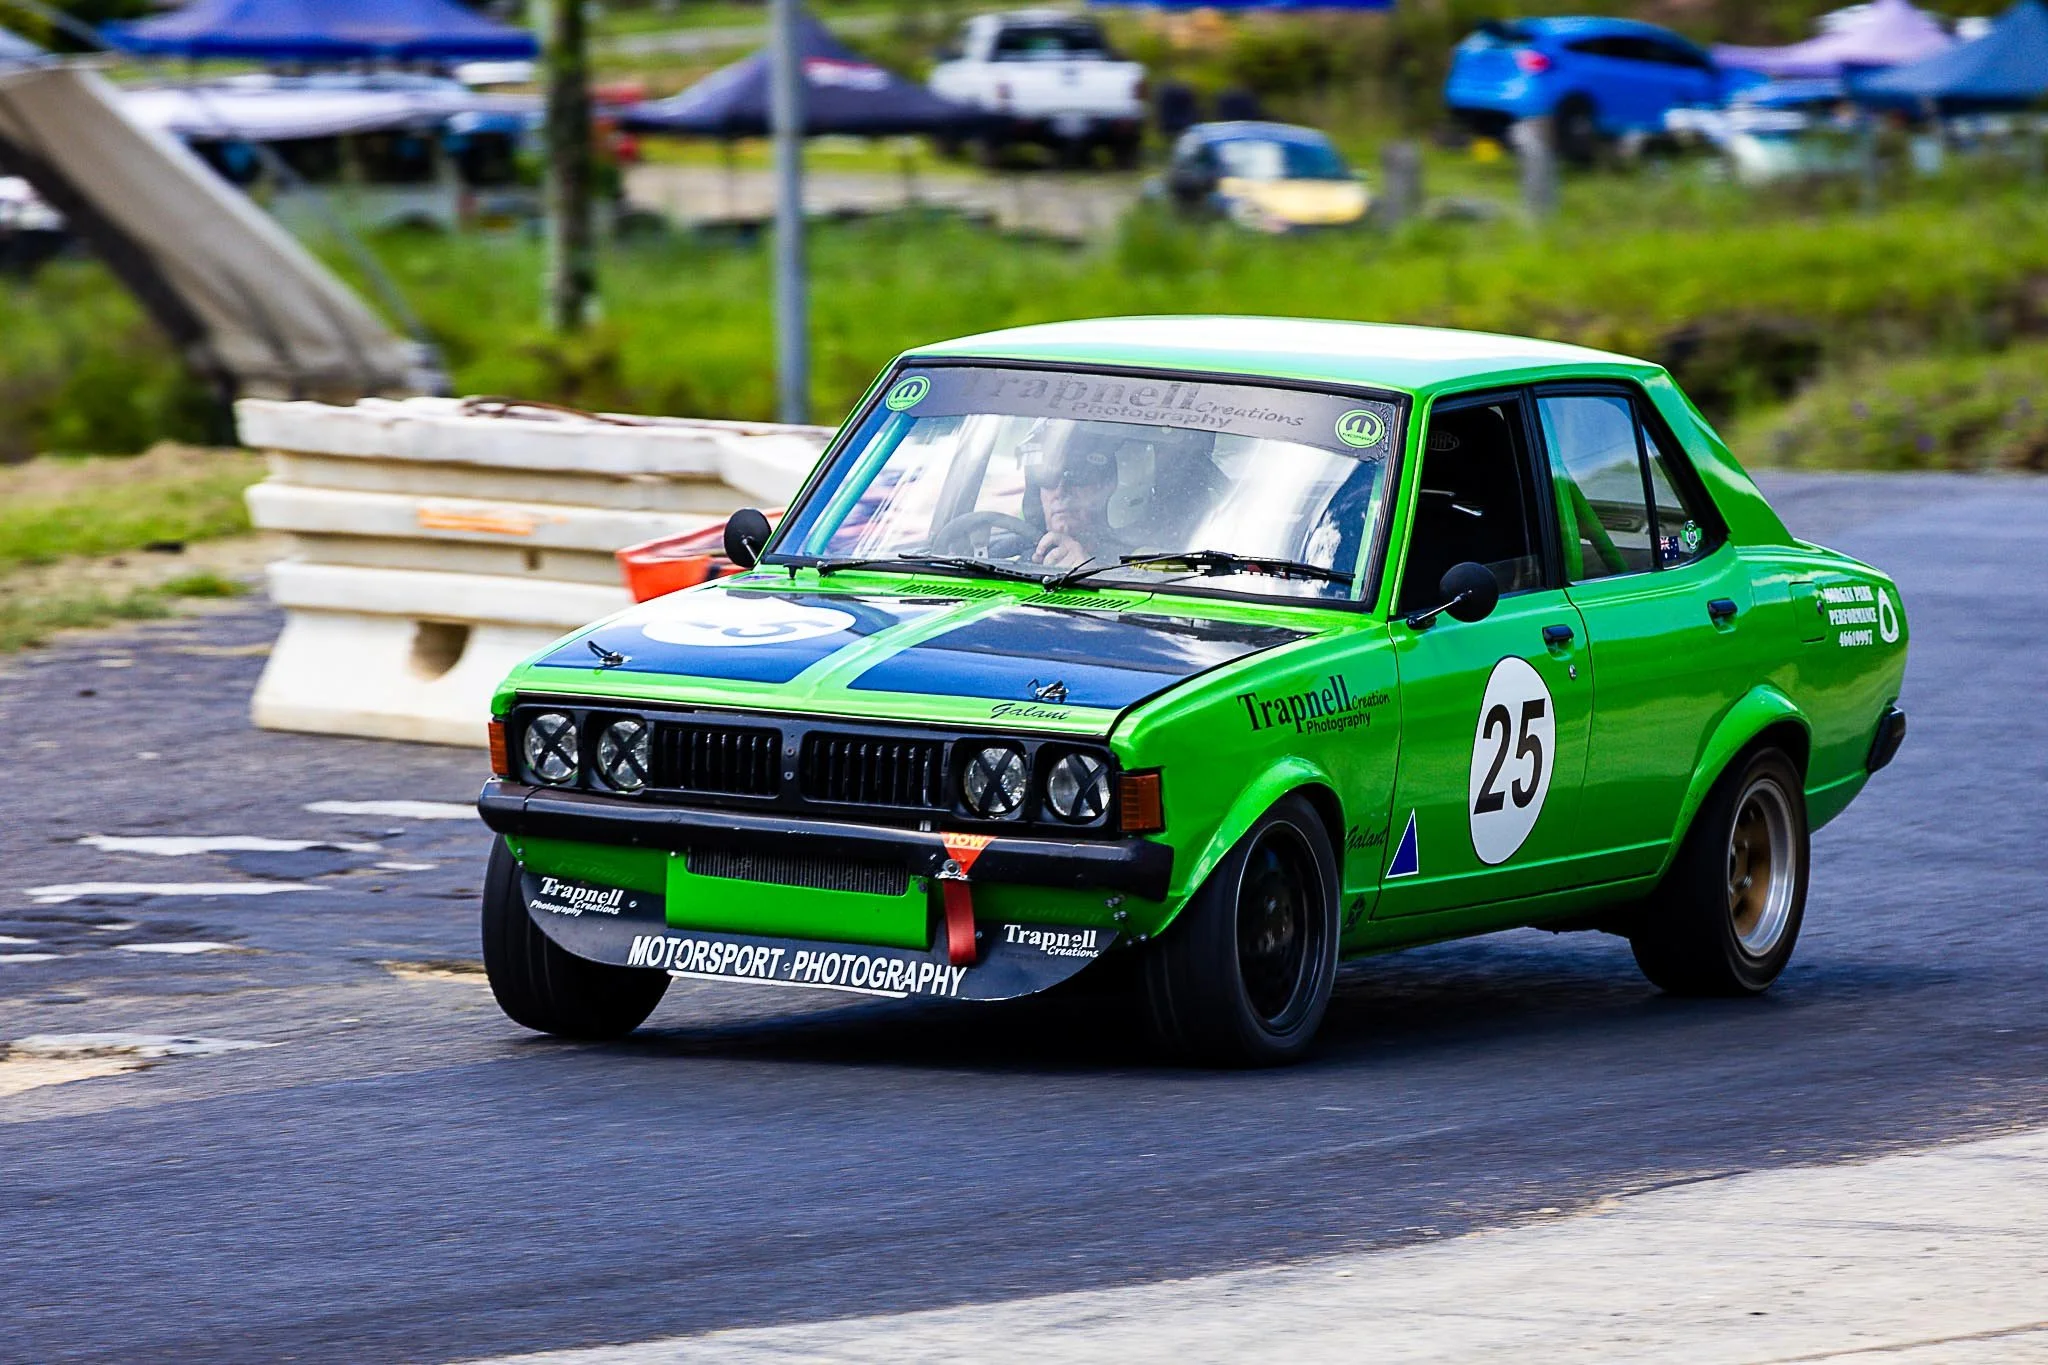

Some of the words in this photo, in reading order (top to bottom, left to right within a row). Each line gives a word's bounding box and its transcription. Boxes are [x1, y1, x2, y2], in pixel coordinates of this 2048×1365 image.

[958, 370, 1202, 411] Trapnell
[1071, 401, 1234, 429] Photography
[1195, 401, 1304, 427] Creations
[1828, 607, 1877, 625] PERFORMANCE
[1236, 674, 1354, 734] Trapnell
[1351, 689, 1391, 711] Creation
[1306, 710, 1371, 735] Photography
[1473, 698, 1546, 815] 25
[949, 833, 985, 847] TOW
[1345, 824, 1388, 854] Galant
[540, 876, 625, 907] Trapnell
[529, 899, 583, 917] Photography
[573, 900, 622, 916] Creations
[1004, 924, 1097, 951] Trapnell
[1046, 945, 1099, 959] Creations
[627, 935, 785, 978] MOTORSPORT
[789, 951, 967, 997] PHOTOGRAPHY
